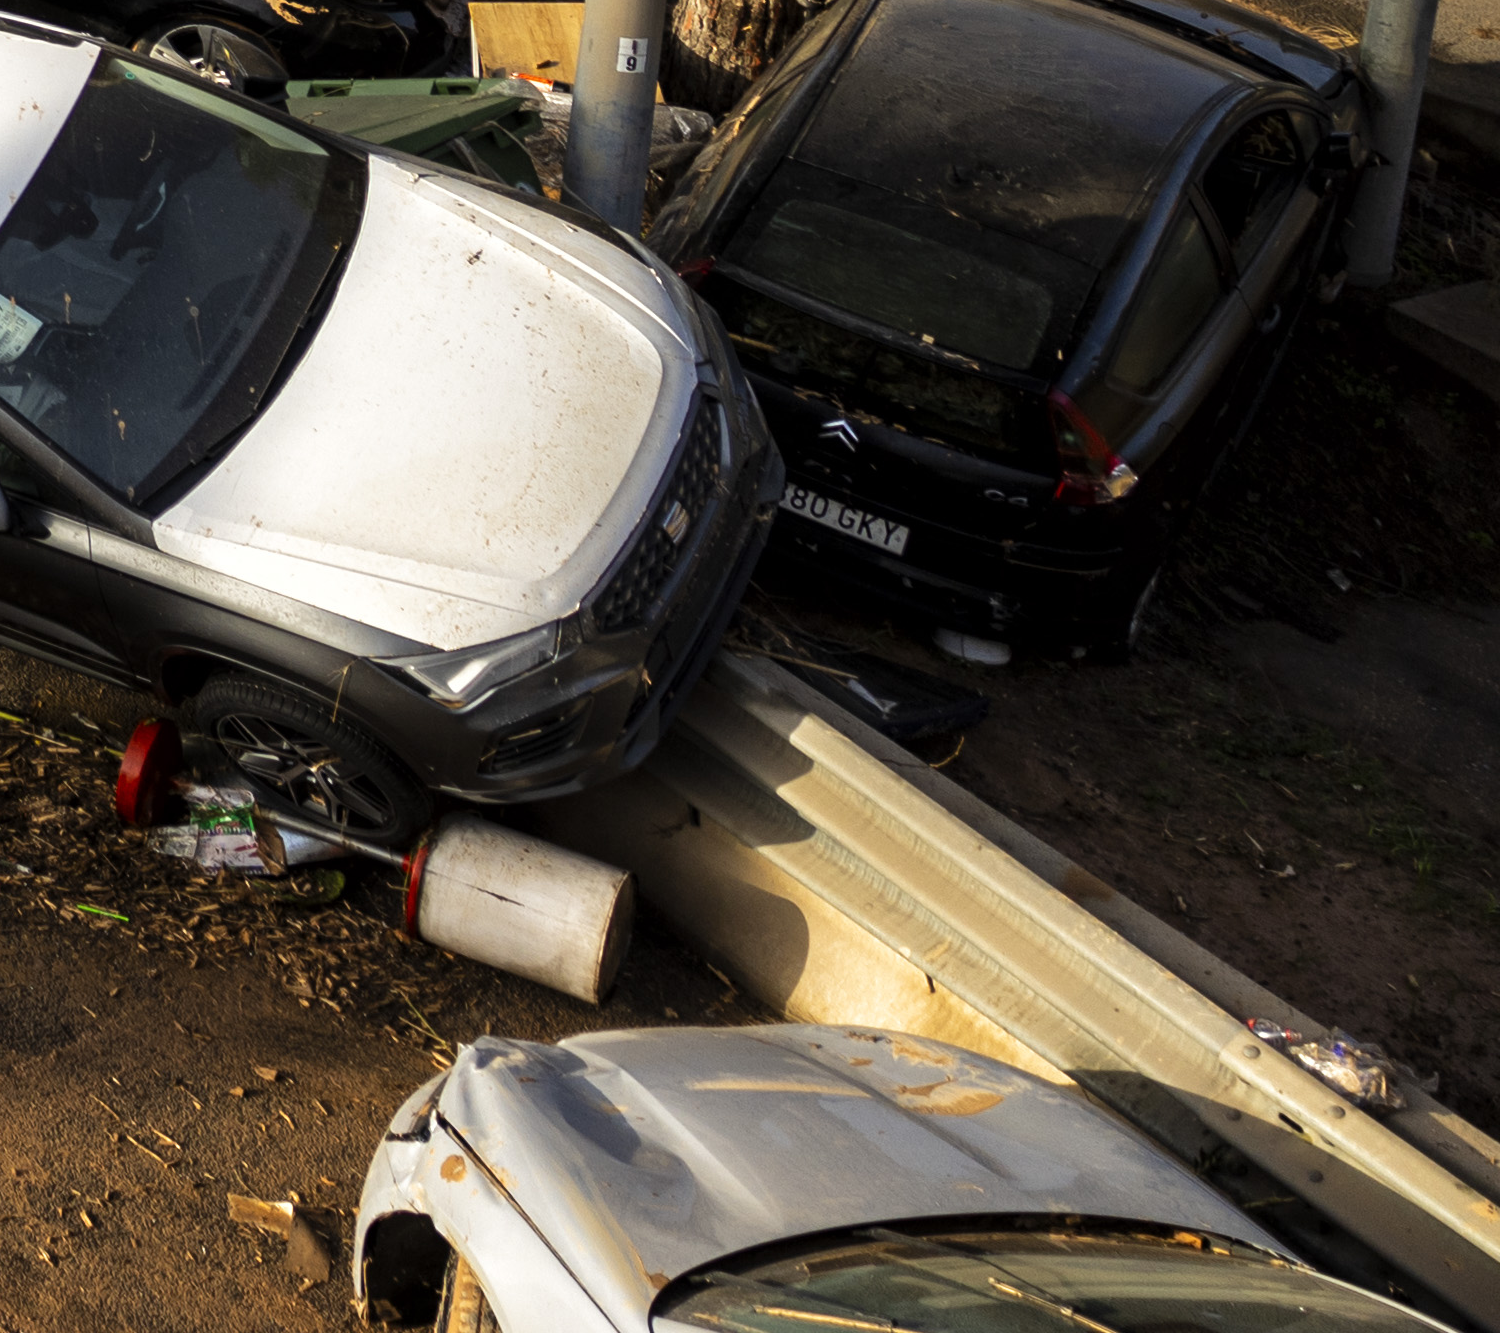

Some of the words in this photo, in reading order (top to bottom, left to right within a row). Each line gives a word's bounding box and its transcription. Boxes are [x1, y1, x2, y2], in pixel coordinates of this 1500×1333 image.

[626, 56, 637, 72] 9
[781, 485, 830, 520] 80
[837, 504, 901, 545] GKY
